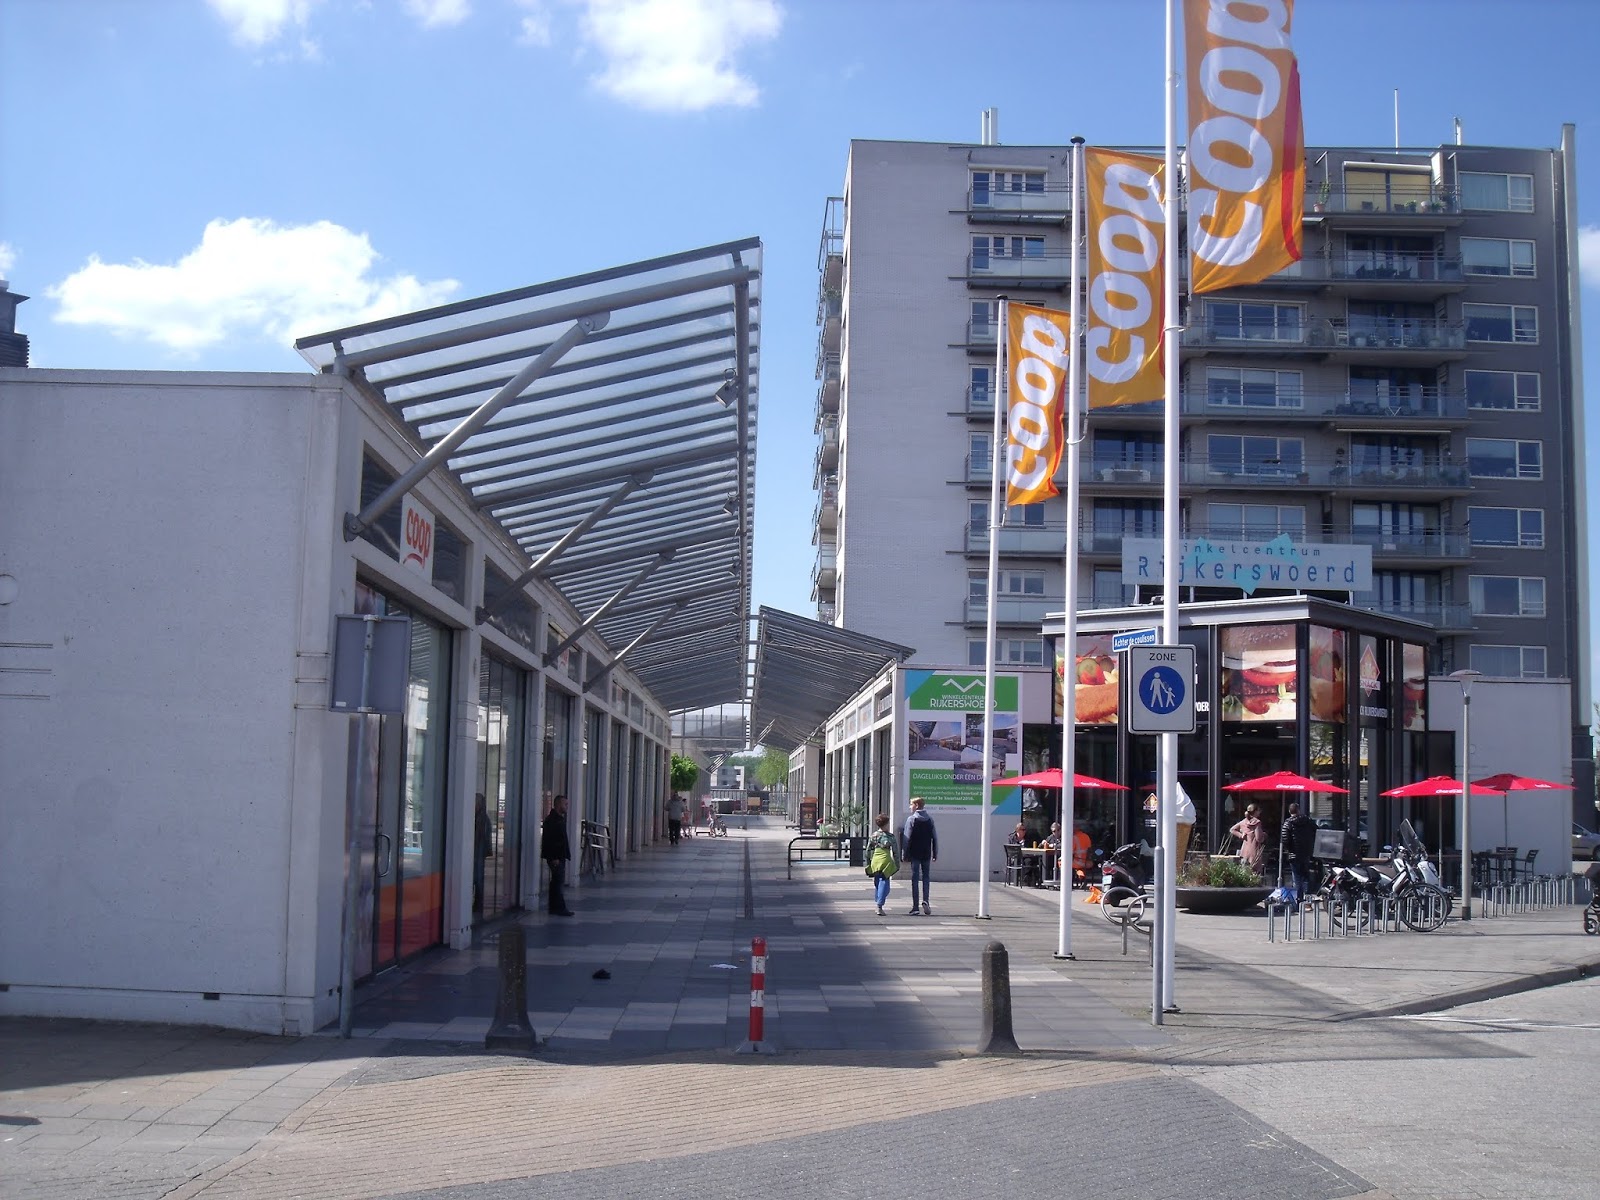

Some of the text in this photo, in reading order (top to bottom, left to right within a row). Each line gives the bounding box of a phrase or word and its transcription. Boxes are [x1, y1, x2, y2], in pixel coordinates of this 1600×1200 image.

[1188, 0, 1290, 267] coop
[1086, 163, 1165, 384] coop
[1007, 314, 1070, 491] coop
[406, 507, 432, 569] coop
[1184, 543, 1321, 557] inkelcentrum
[1114, 634, 1155, 648] Achter de coulissen
[1149, 652, 1176, 661] ZONE
